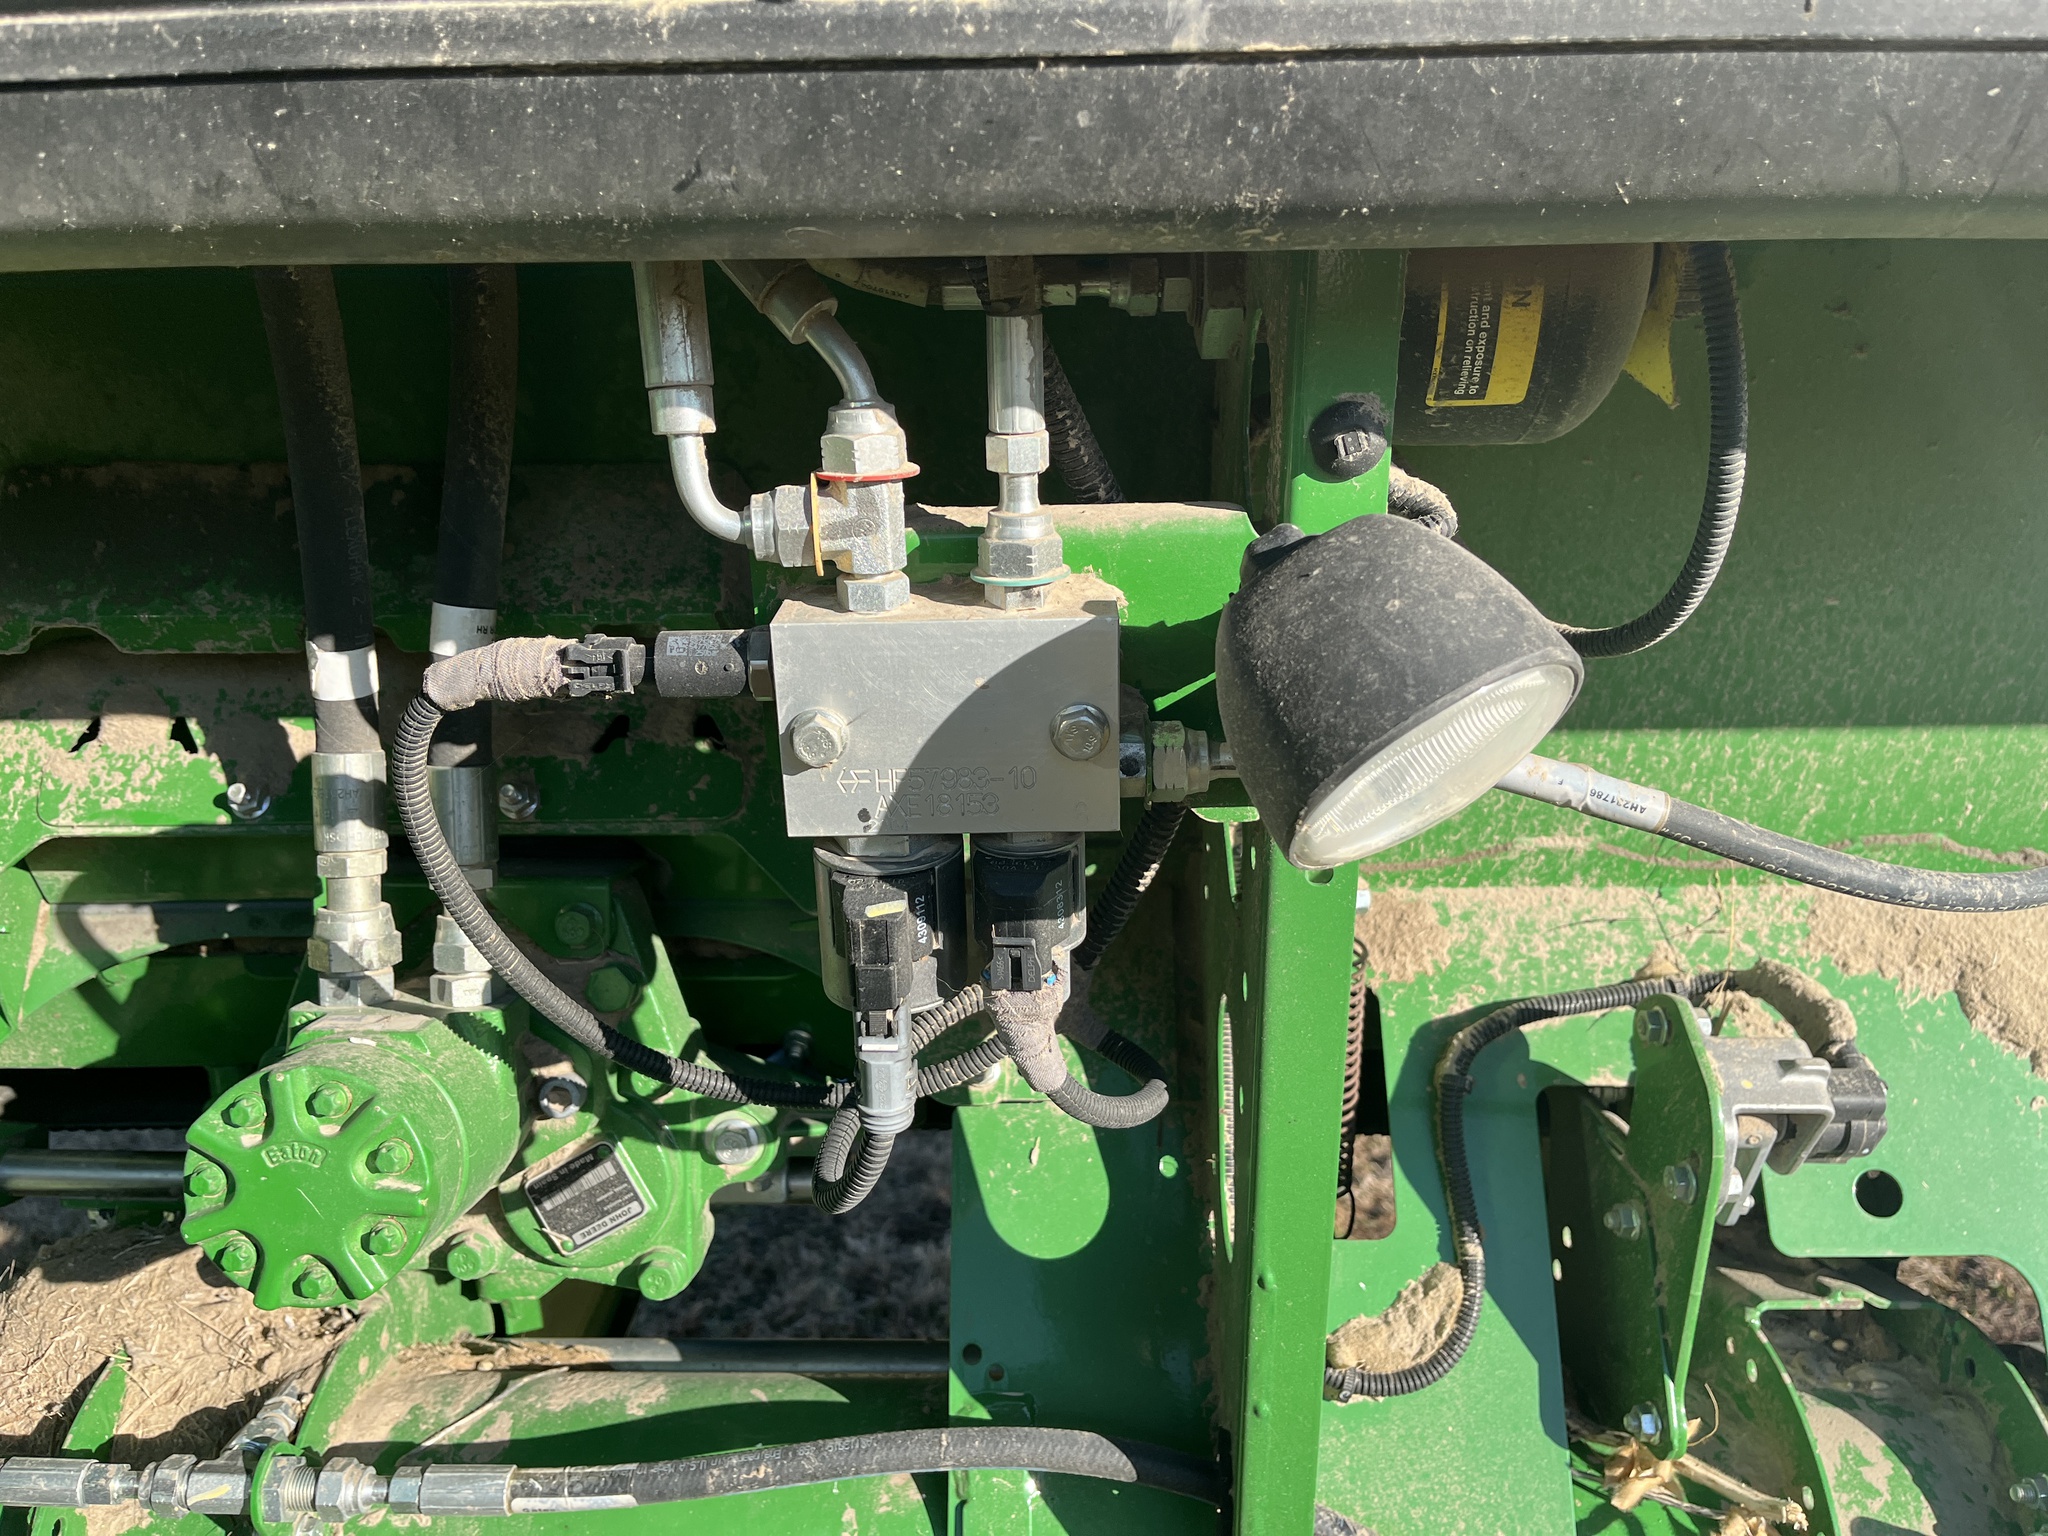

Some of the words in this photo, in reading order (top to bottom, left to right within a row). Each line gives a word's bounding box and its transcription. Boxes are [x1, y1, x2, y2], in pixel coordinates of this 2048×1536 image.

[1480, 305, 1491, 328] and
[1464, 339, 1474, 353] on
[1471, 331, 1488, 383] exposure
[1453, 355, 1473, 395] relieving
[1468, 385, 1479, 395] to
[875, 792, 1000, 818] AXE18153
[1055, 879, 1065, 929] 4308312
[916, 895, 927, 944] 4309112
[266, 1142, 322, 1165] Eaton
[569, 1153, 594, 1171] Made
[533, 1172, 559, 1190] Spain
[559, 1167, 568, 1176] in
[608, 1207, 633, 1223] JOHN
[578, 1221, 609, 1240] DEERE
